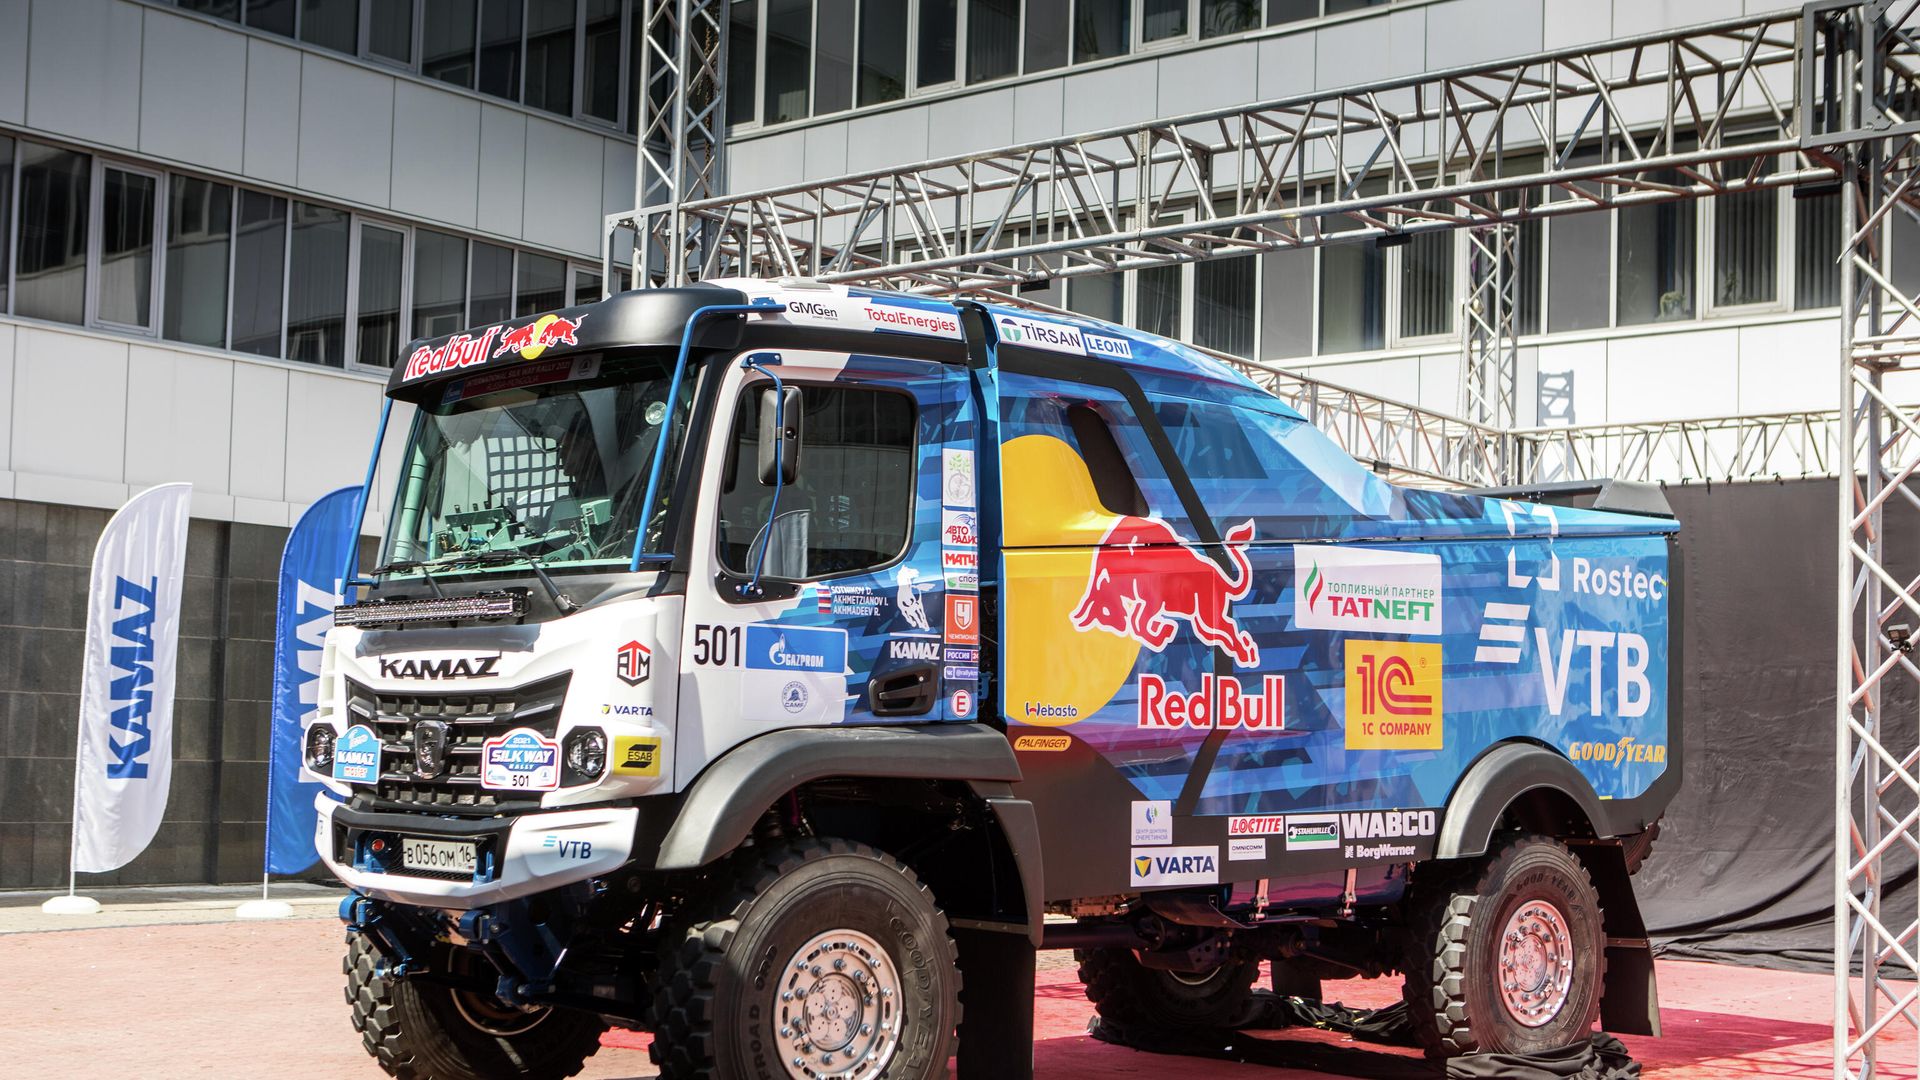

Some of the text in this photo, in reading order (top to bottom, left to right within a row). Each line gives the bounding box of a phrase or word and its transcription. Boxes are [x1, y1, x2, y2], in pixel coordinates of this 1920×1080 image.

[789, 301, 838, 317] GMGen
[864, 307, 956, 333] TotalEnergies
[1088, 338, 1130, 356] LEONI
[1573, 557, 1664, 601] Rostec
[1328, 581, 1435, 599] ТОПЛИВНЫЙ ПАРТНЕР
[833, 595, 883, 606] AKHMETZIANOV
[1328, 596, 1434, 622] TATNEFT
[833, 605, 873, 616] AKHMADEEV
[694, 624, 741, 667] 501
[890, 641, 940, 660] KAMAZ
[381, 656, 502, 680] KAMAZ
[786, 653, 825, 667] GAZPROM
[107, 575, 158, 779] KAMAZ
[1534, 627, 1651, 717] VTB
[613, 704, 653, 716] VARTA
[956, 695, 966, 712] E
[1025, 701, 1078, 718] Webasto
[1137, 673, 1285, 731] Red Bull
[1362, 722, 1431, 735] 1C COMPANY
[1017, 738, 1068, 748] PALFINGER
[337, 751, 376, 766] KAMAZ
[490, 749, 554, 763] SILK WAY
[627, 751, 653, 762] ESAB
[512, 775, 530, 787] 501
[1230, 817, 1282, 833] LOCTITE
[1341, 810, 1436, 839] WABCO
[459, 846, 471, 862] 16
[559, 840, 591, 860] VTB
[1356, 844, 1416, 860] BorgWarner
[1156, 856, 1214, 874] VARTA
